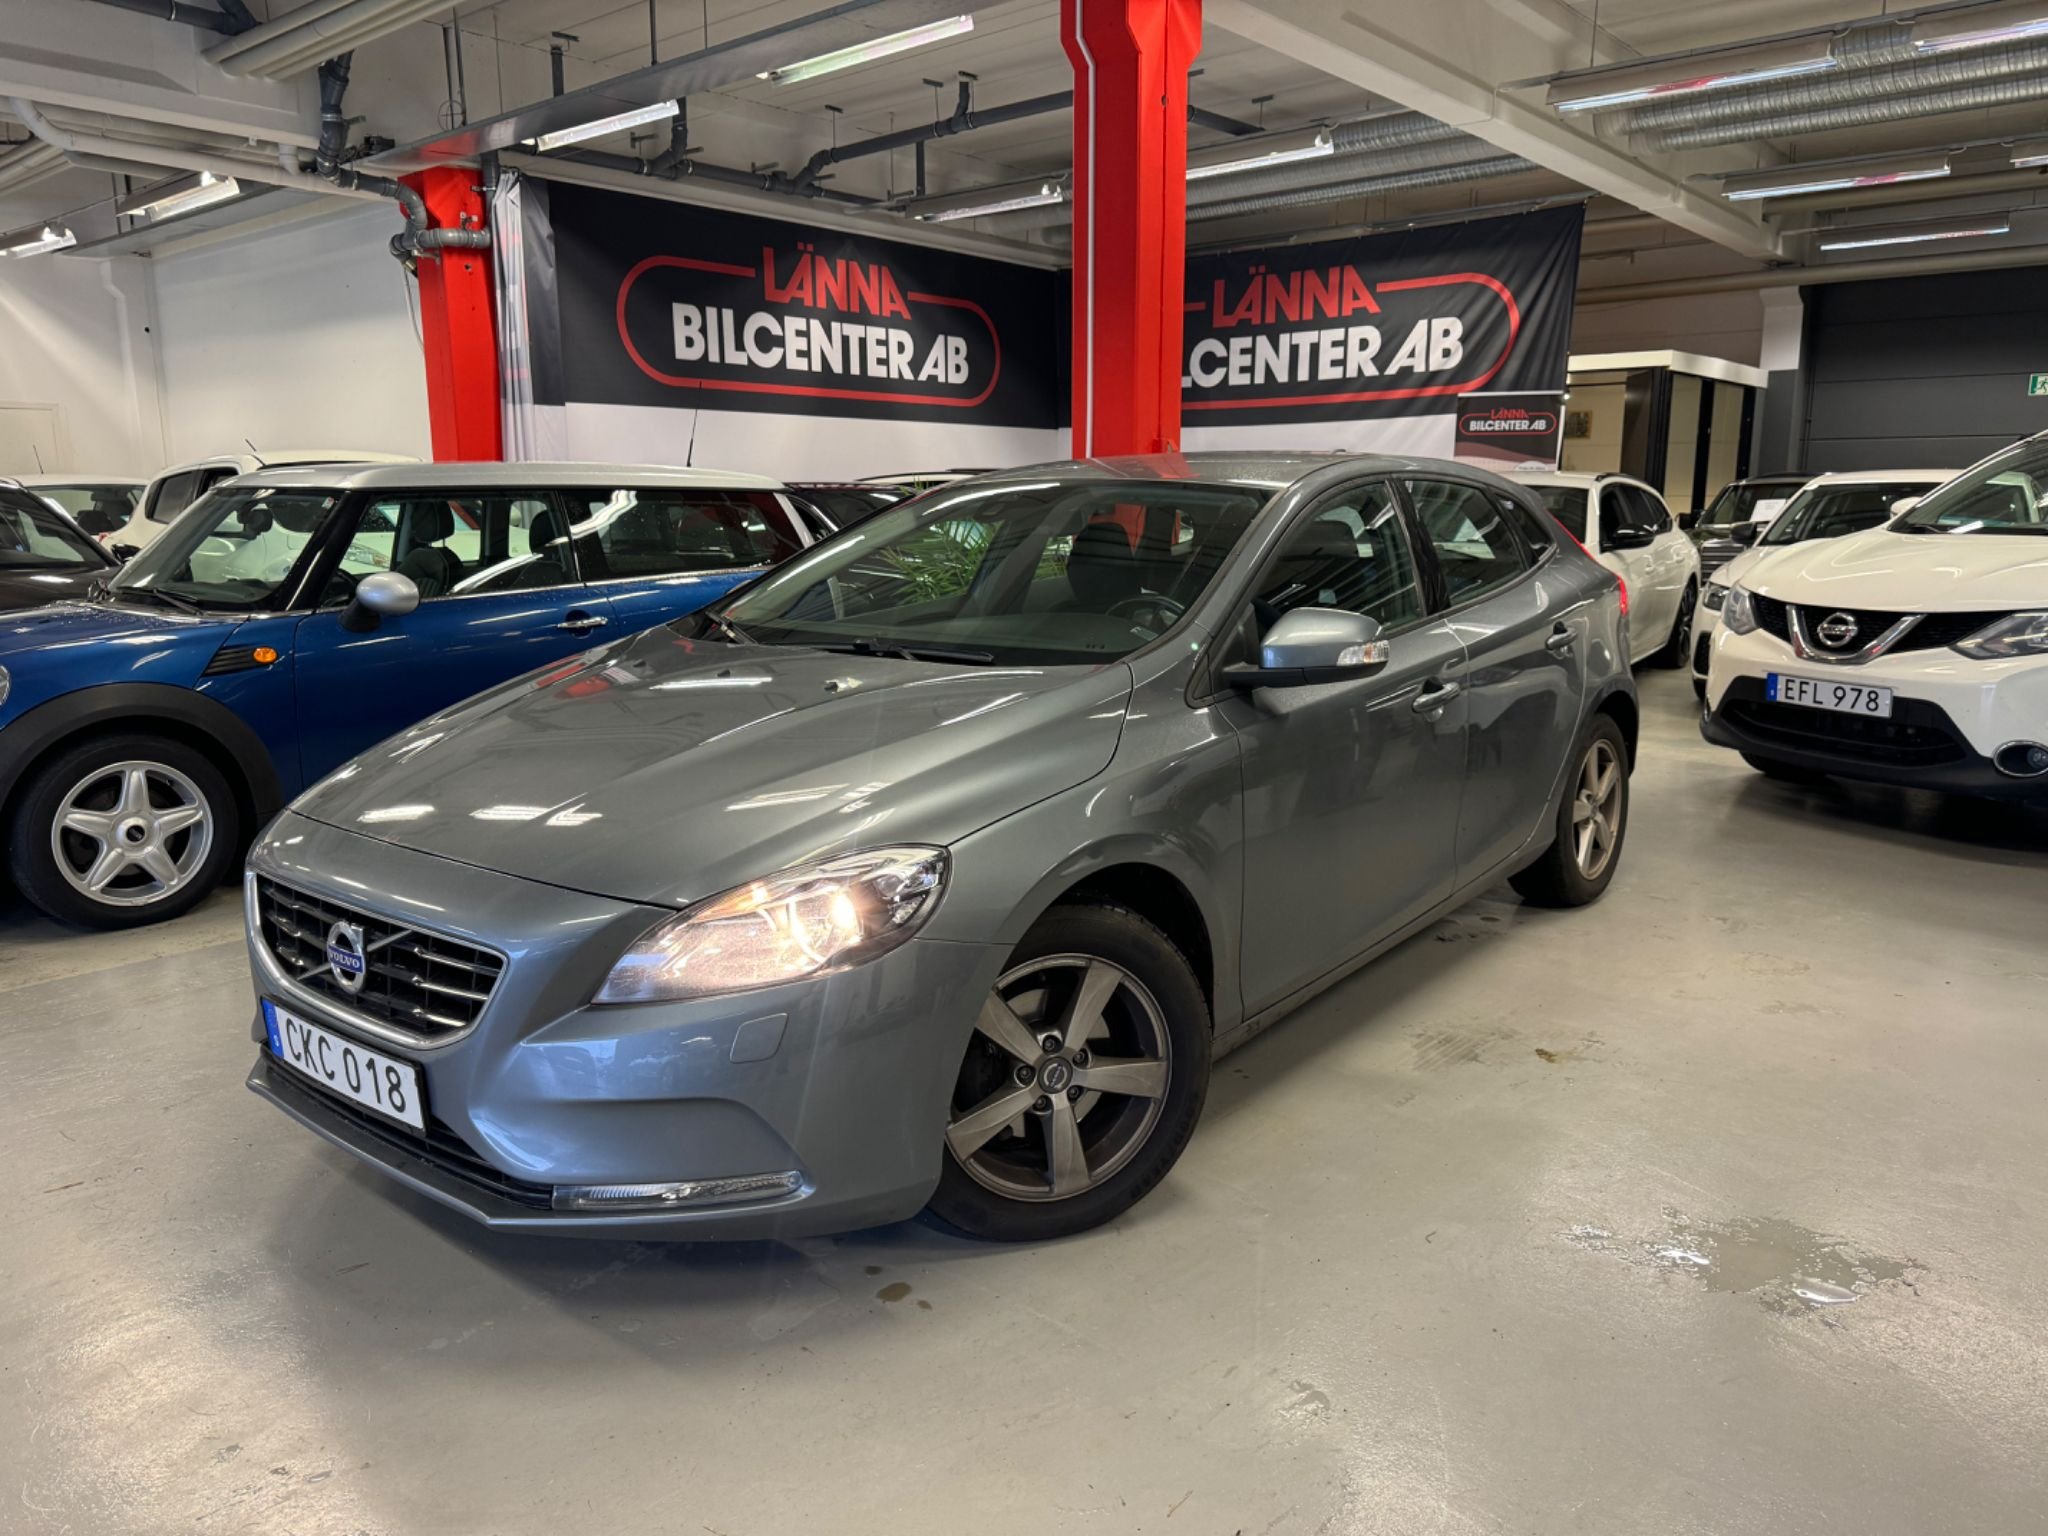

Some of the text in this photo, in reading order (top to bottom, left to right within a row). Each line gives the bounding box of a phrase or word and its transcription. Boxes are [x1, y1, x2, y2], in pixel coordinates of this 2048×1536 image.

[762, 241, 912, 320] LÄNNA
[1212, 264, 1381, 328] LÄNNA
[672, 302, 970, 385] BILCENTER AB
[1181, 316, 1463, 388] CENTER AB
[1470, 419, 1547, 431] BILCENTER AB
[1785, 679, 1879, 712] EFL 978
[328, 949, 361, 969] VOLVO
[286, 1017, 406, 1113] CKC 018
